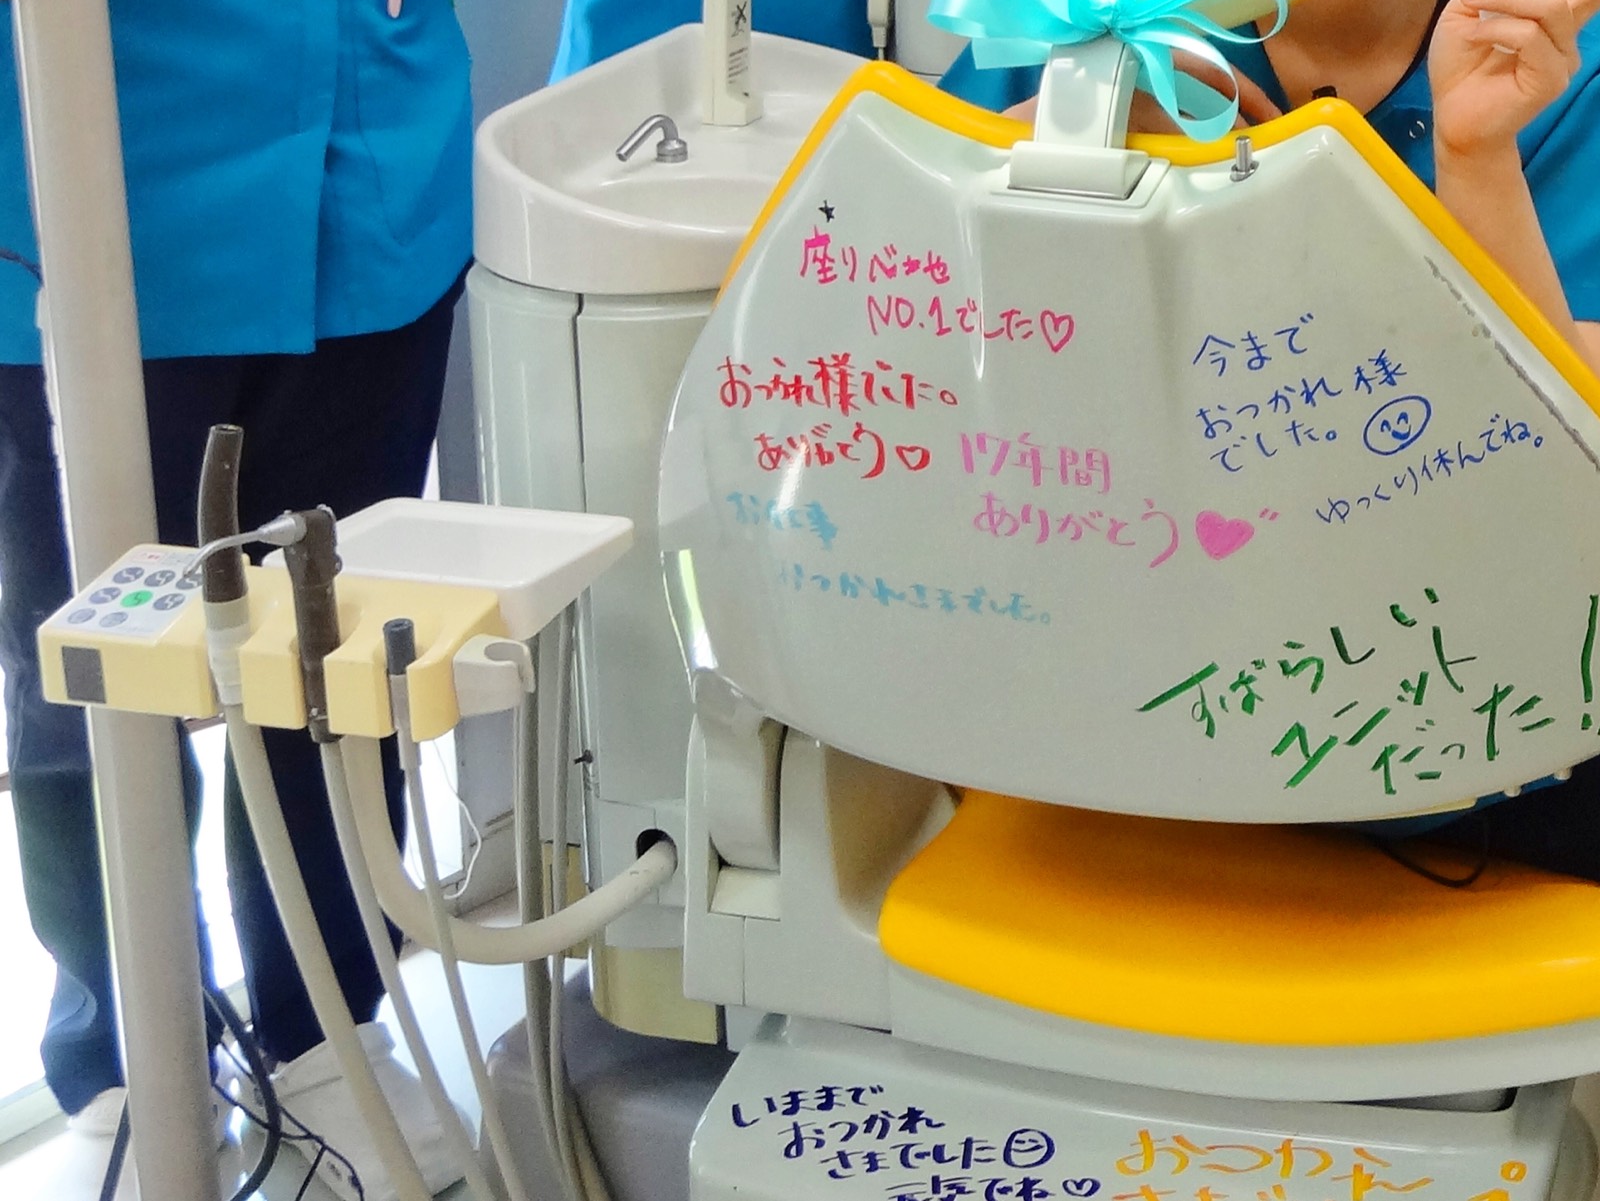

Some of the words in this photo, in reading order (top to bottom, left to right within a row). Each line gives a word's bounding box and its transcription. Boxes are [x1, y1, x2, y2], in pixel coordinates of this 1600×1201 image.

[1193, 313, 1315, 377] 今まで
[1195, 348, 1408, 440] おつかれ様
[960, 431, 1112, 495] 17年間
[1210, 418, 1340, 473] でした。
[1315, 412, 1545, 525] ゆっくり休んでね。
[974, 491, 1180, 569] ありがとう
[1135, 587, 1441, 739] すばらしい
[1271, 625, 1478, 790] ユニット
[731, 1084, 884, 1129] いままで
[777, 1106, 946, 1159] おつかれ
[819, 1136, 998, 1179] さまでした
